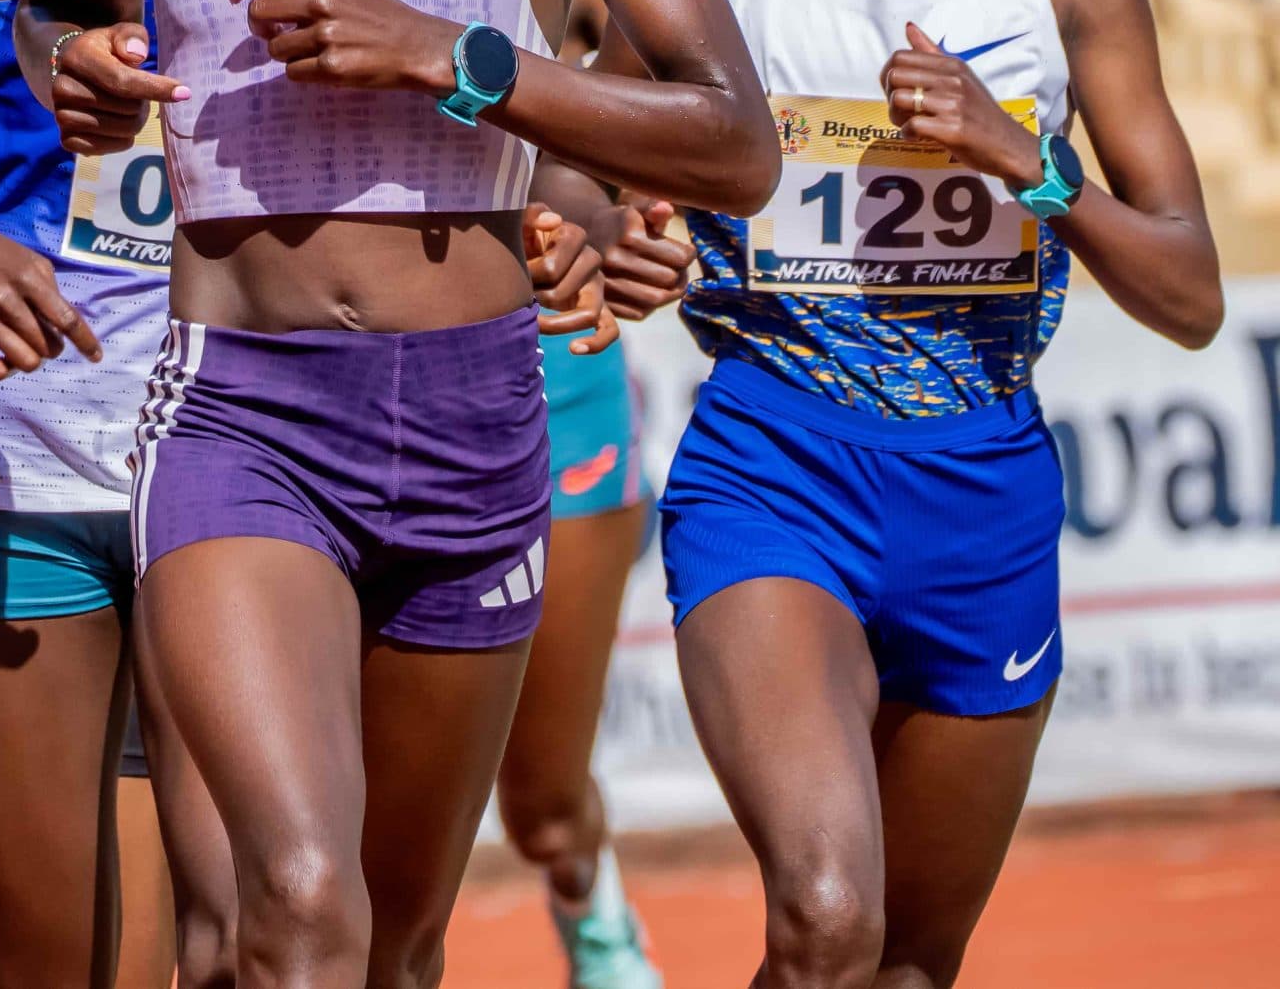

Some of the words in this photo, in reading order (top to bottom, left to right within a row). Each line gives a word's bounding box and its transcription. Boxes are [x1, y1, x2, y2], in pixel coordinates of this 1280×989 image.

[120, 155, 174, 227] 0
[801, 171, 993, 248] 129
[777, 260, 901, 284] NATIONAL
[912, 261, 1012, 283] FINALS
